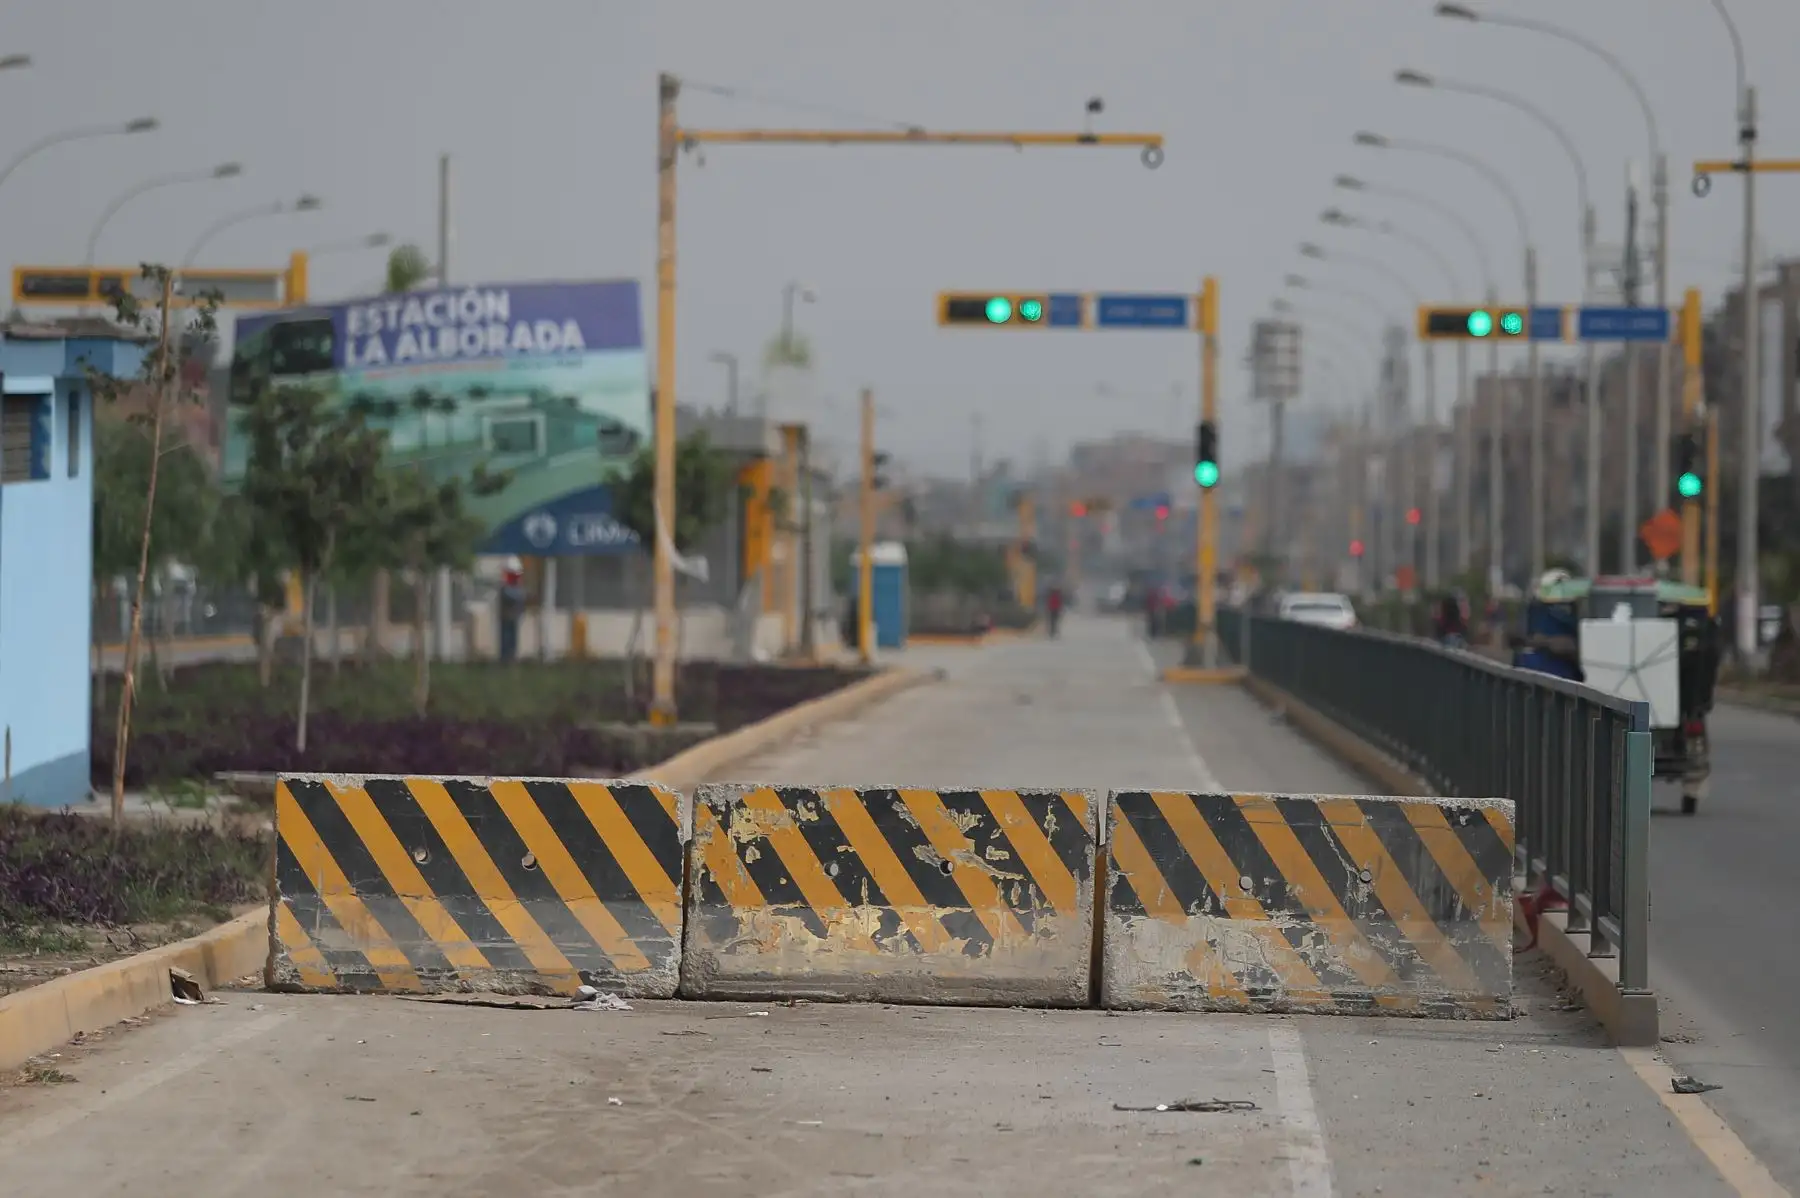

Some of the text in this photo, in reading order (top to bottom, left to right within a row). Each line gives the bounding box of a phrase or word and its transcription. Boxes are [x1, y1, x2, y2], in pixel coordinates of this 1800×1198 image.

[346, 285, 510, 335] ESTACIÓN
[345, 319, 586, 366] LA ALBORADA
